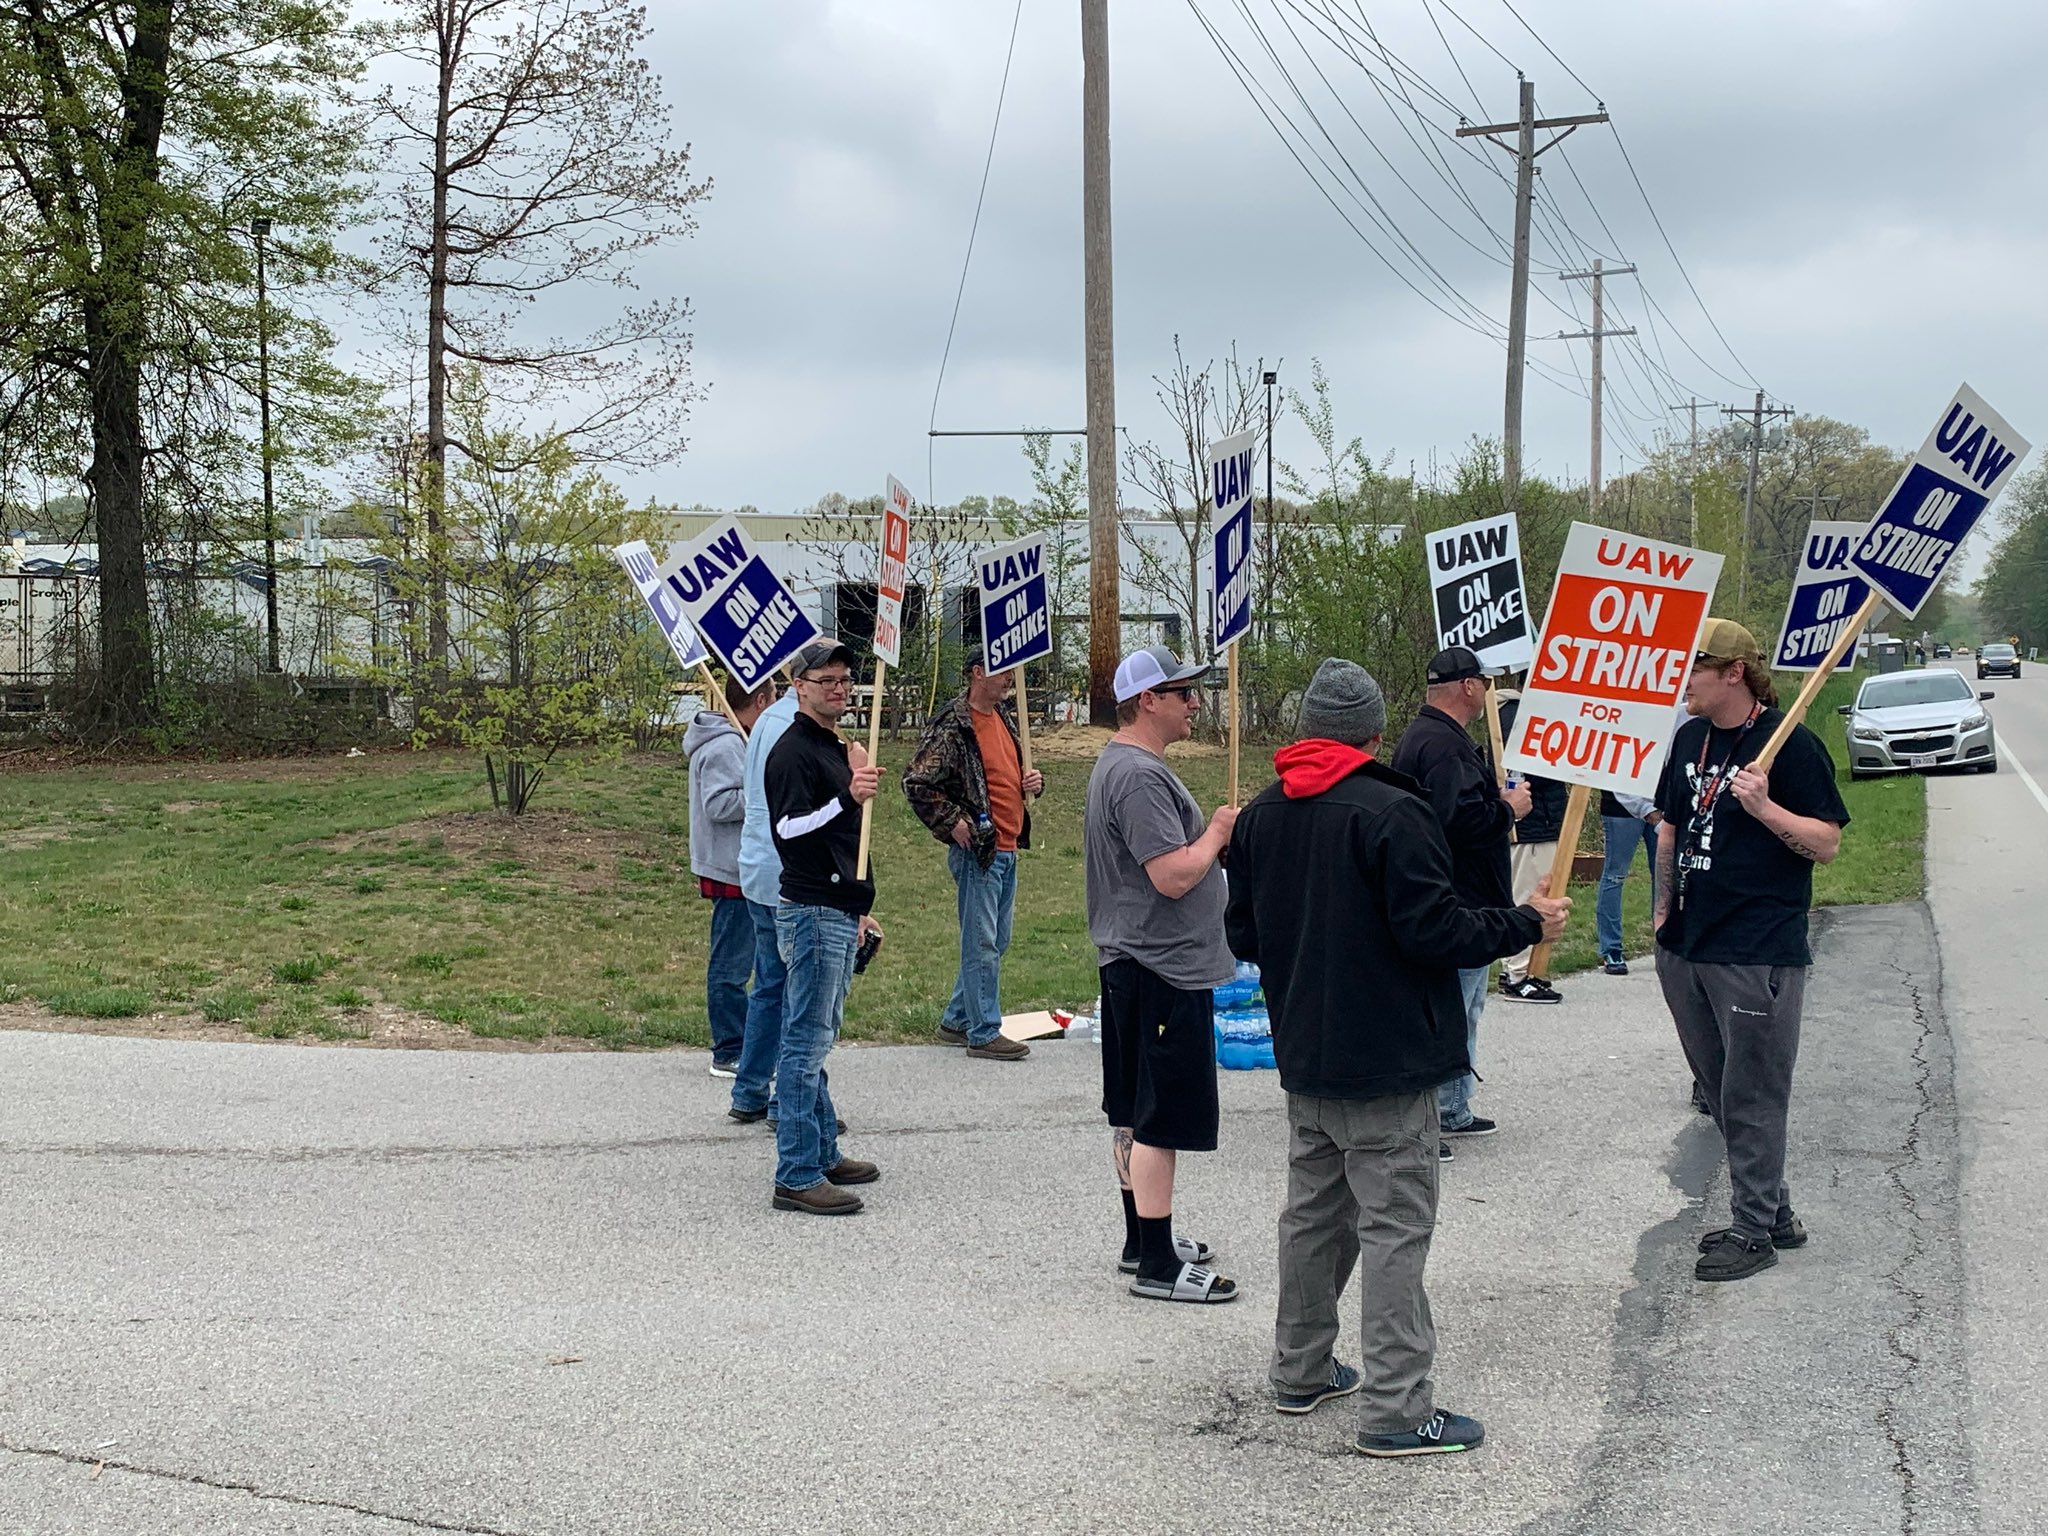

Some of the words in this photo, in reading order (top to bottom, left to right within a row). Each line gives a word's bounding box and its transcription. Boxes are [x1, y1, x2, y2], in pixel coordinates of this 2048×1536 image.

[1936, 402, 2016, 491] UAW
[894, 485, 908, 513] UAW
[1214, 448, 1252, 509] UAW
[1913, 487, 1962, 531] ON
[891, 518, 902, 554] ON
[1228, 517, 1242, 574] ON
[1435, 525, 1508, 572] UAW
[1597, 538, 1694, 581] UAW
[1807, 535, 1860, 570] UA
[1860, 522, 1954, 579] STRIKE
[667, 527, 748, 603] UAW
[982, 544, 1041, 591] UAW
[725, 582, 761, 629] ON
[1005, 590, 1028, 627] ON
[1217, 553, 1250, 637] STRIKE
[1459, 572, 1490, 614] ON
[1590, 586, 1664, 637] ON
[1816, 584, 1850, 621] ON
[732, 590, 797, 678] STRIKE
[990, 608, 1046, 667] STRIKE
[1541, 634, 1687, 694] STRIKE
[1579, 702, 1622, 724] FOR
[1520, 715, 1656, 779] EQUITY
